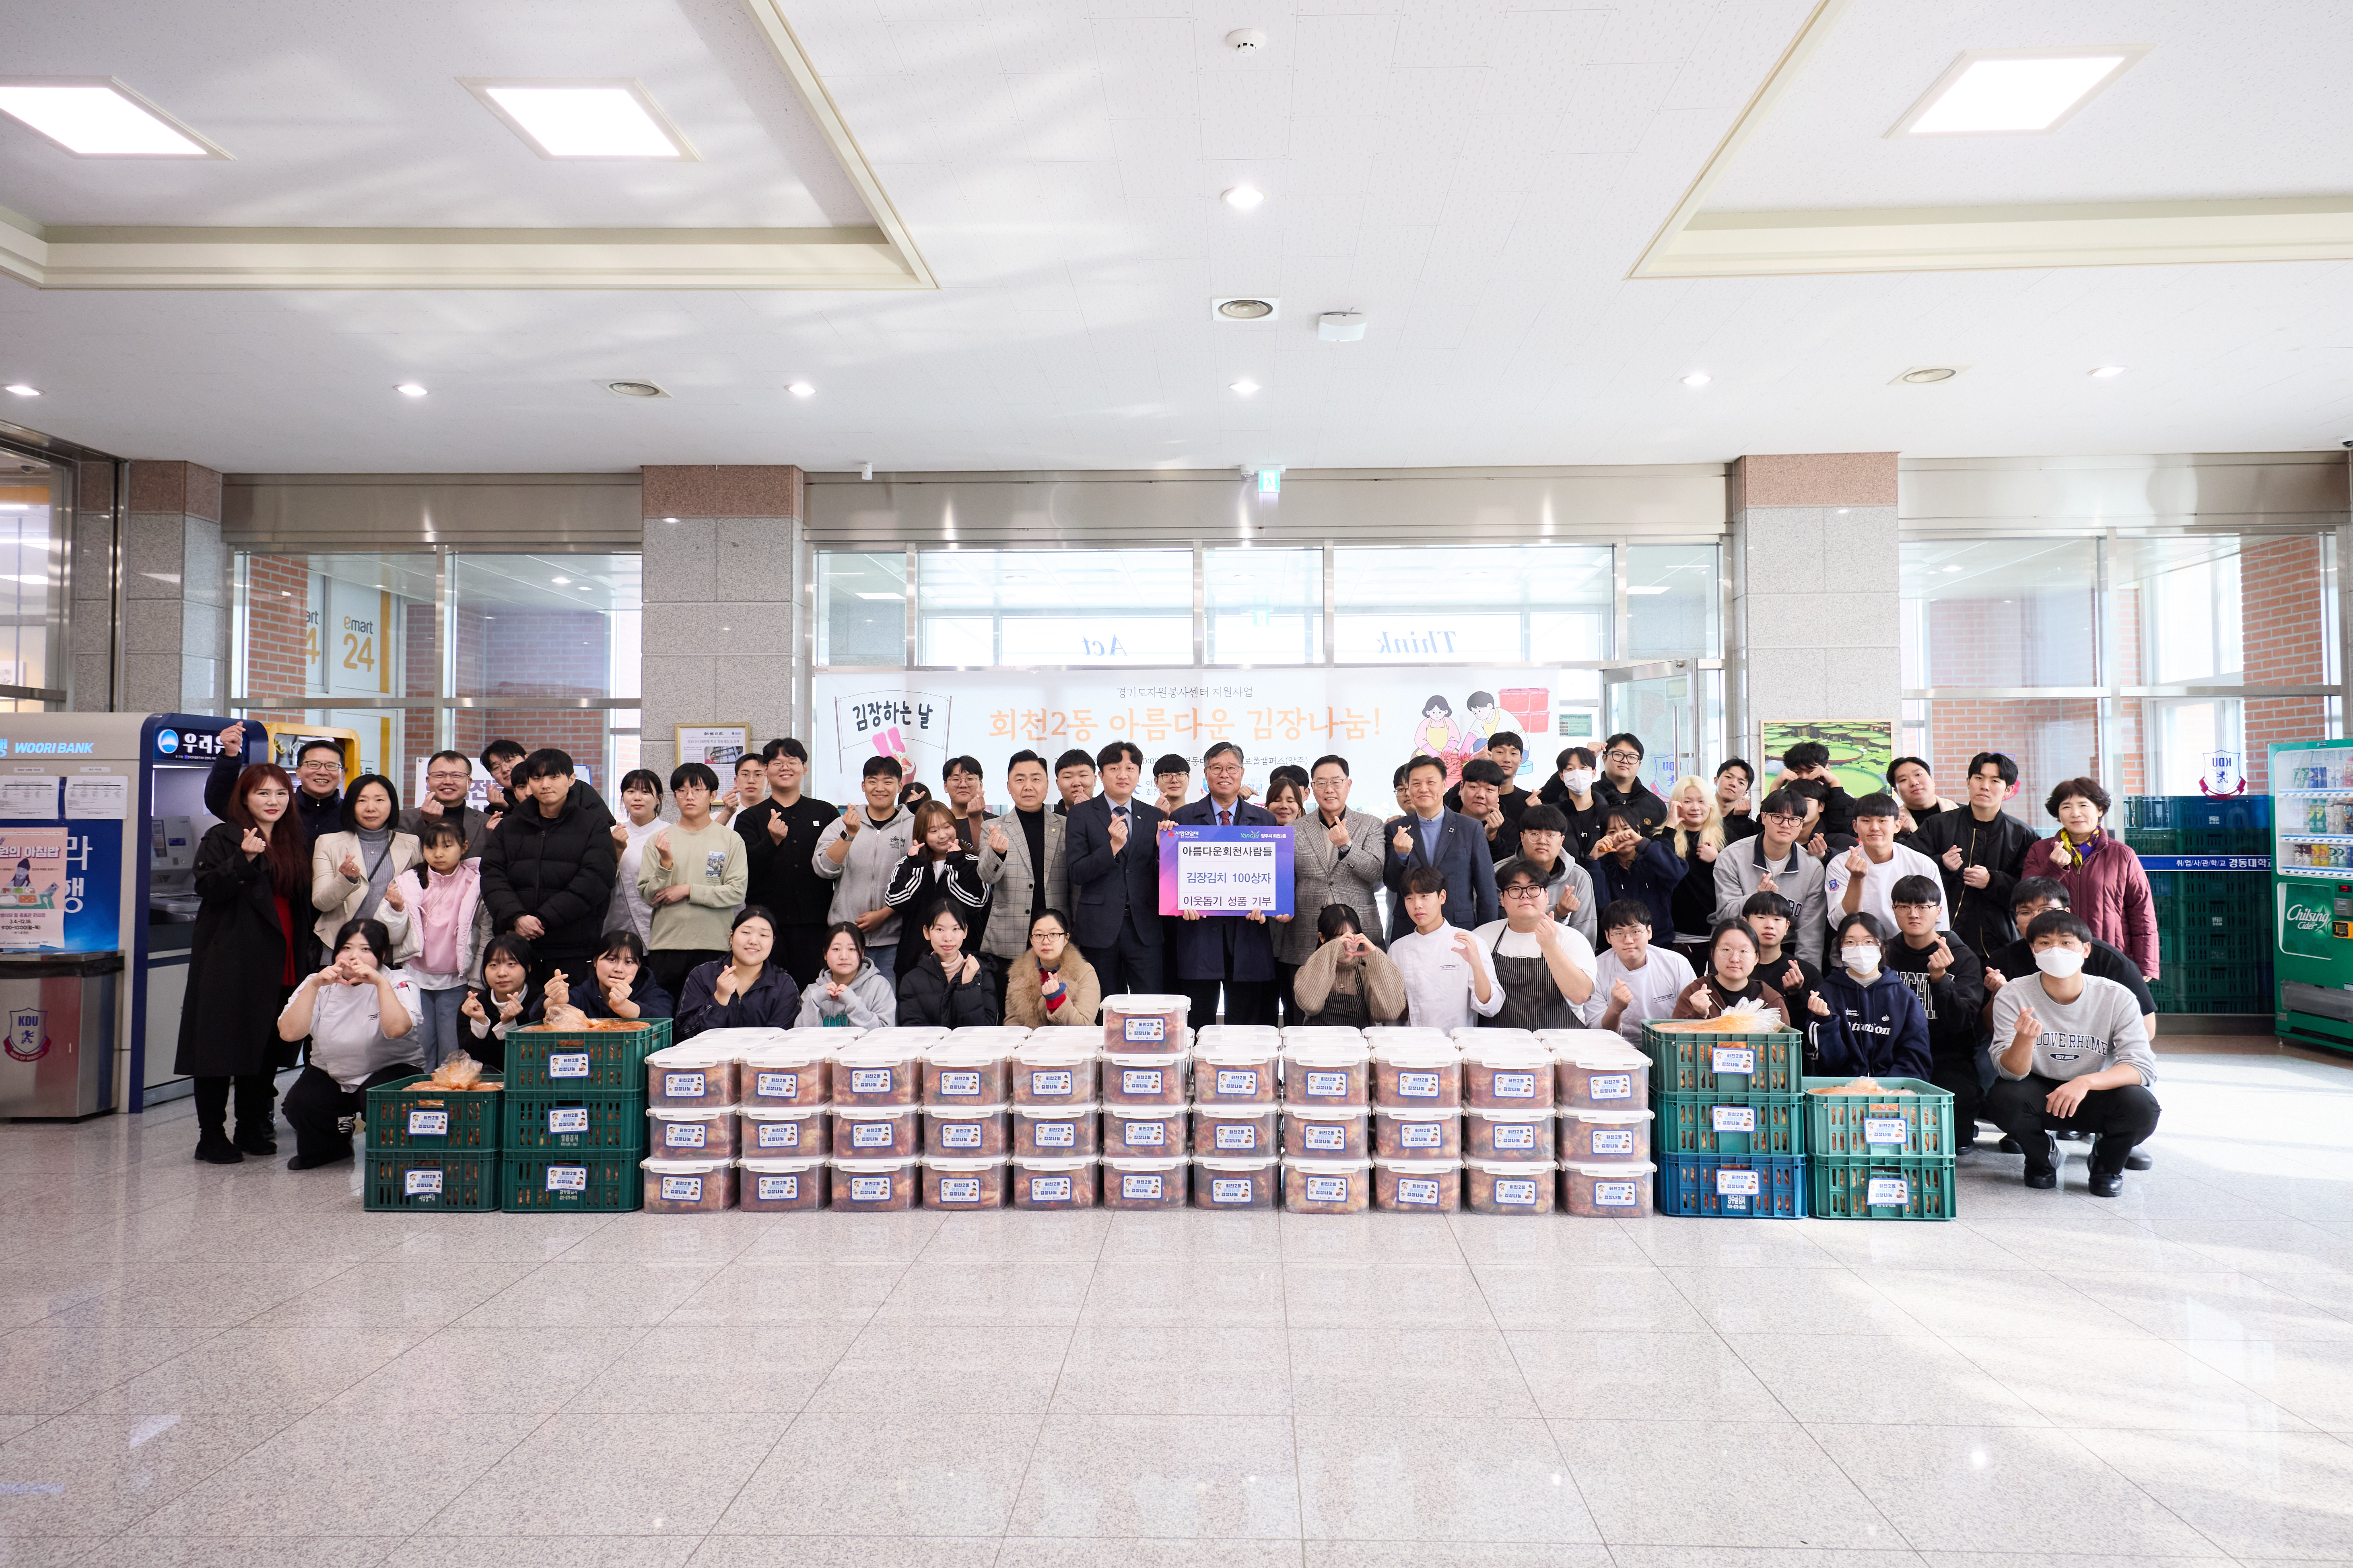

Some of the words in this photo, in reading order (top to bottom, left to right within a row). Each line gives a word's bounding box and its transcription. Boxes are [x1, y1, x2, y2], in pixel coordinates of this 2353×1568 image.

[307, 611, 319, 625] art
[344, 616, 373, 634] emart
[306, 627, 320, 665] 4
[344, 633, 375, 672] 24
[1117, 687, 1209, 699] 경기도자원봉사센터
[1212, 686, 1253, 698] 지원사업
[853, 700, 912, 732] 김장하는
[918, 703, 933, 729] 날
[989, 708, 1099, 742] 회천2동
[1109, 707, 1235, 742] 아름다운
[1247, 706, 1380, 741] 김장나눔!
[15, 743, 56, 753] WOORI
[57, 743, 94, 753] BANK
[1243, 756, 1308, 765] 로폴캠퍼스(양주)
[0, 846, 21, 858] 원의
[24, 846, 60, 858] 아침밥
[1183, 846, 1273, 857] 아름다운회천사람들
[1187, 872, 1227, 884] 김장김치
[1232, 872, 1271, 884] 100상자
[1183, 896, 1222, 907] 이웃돕기
[1228, 896, 1247, 907] 성품
[1253, 897, 1272, 907] 기부
[2297, 922, 2318, 930] Cider
[18, 1016, 38, 1026] KDU
[2069, 1034, 2108, 1056] RHYME
